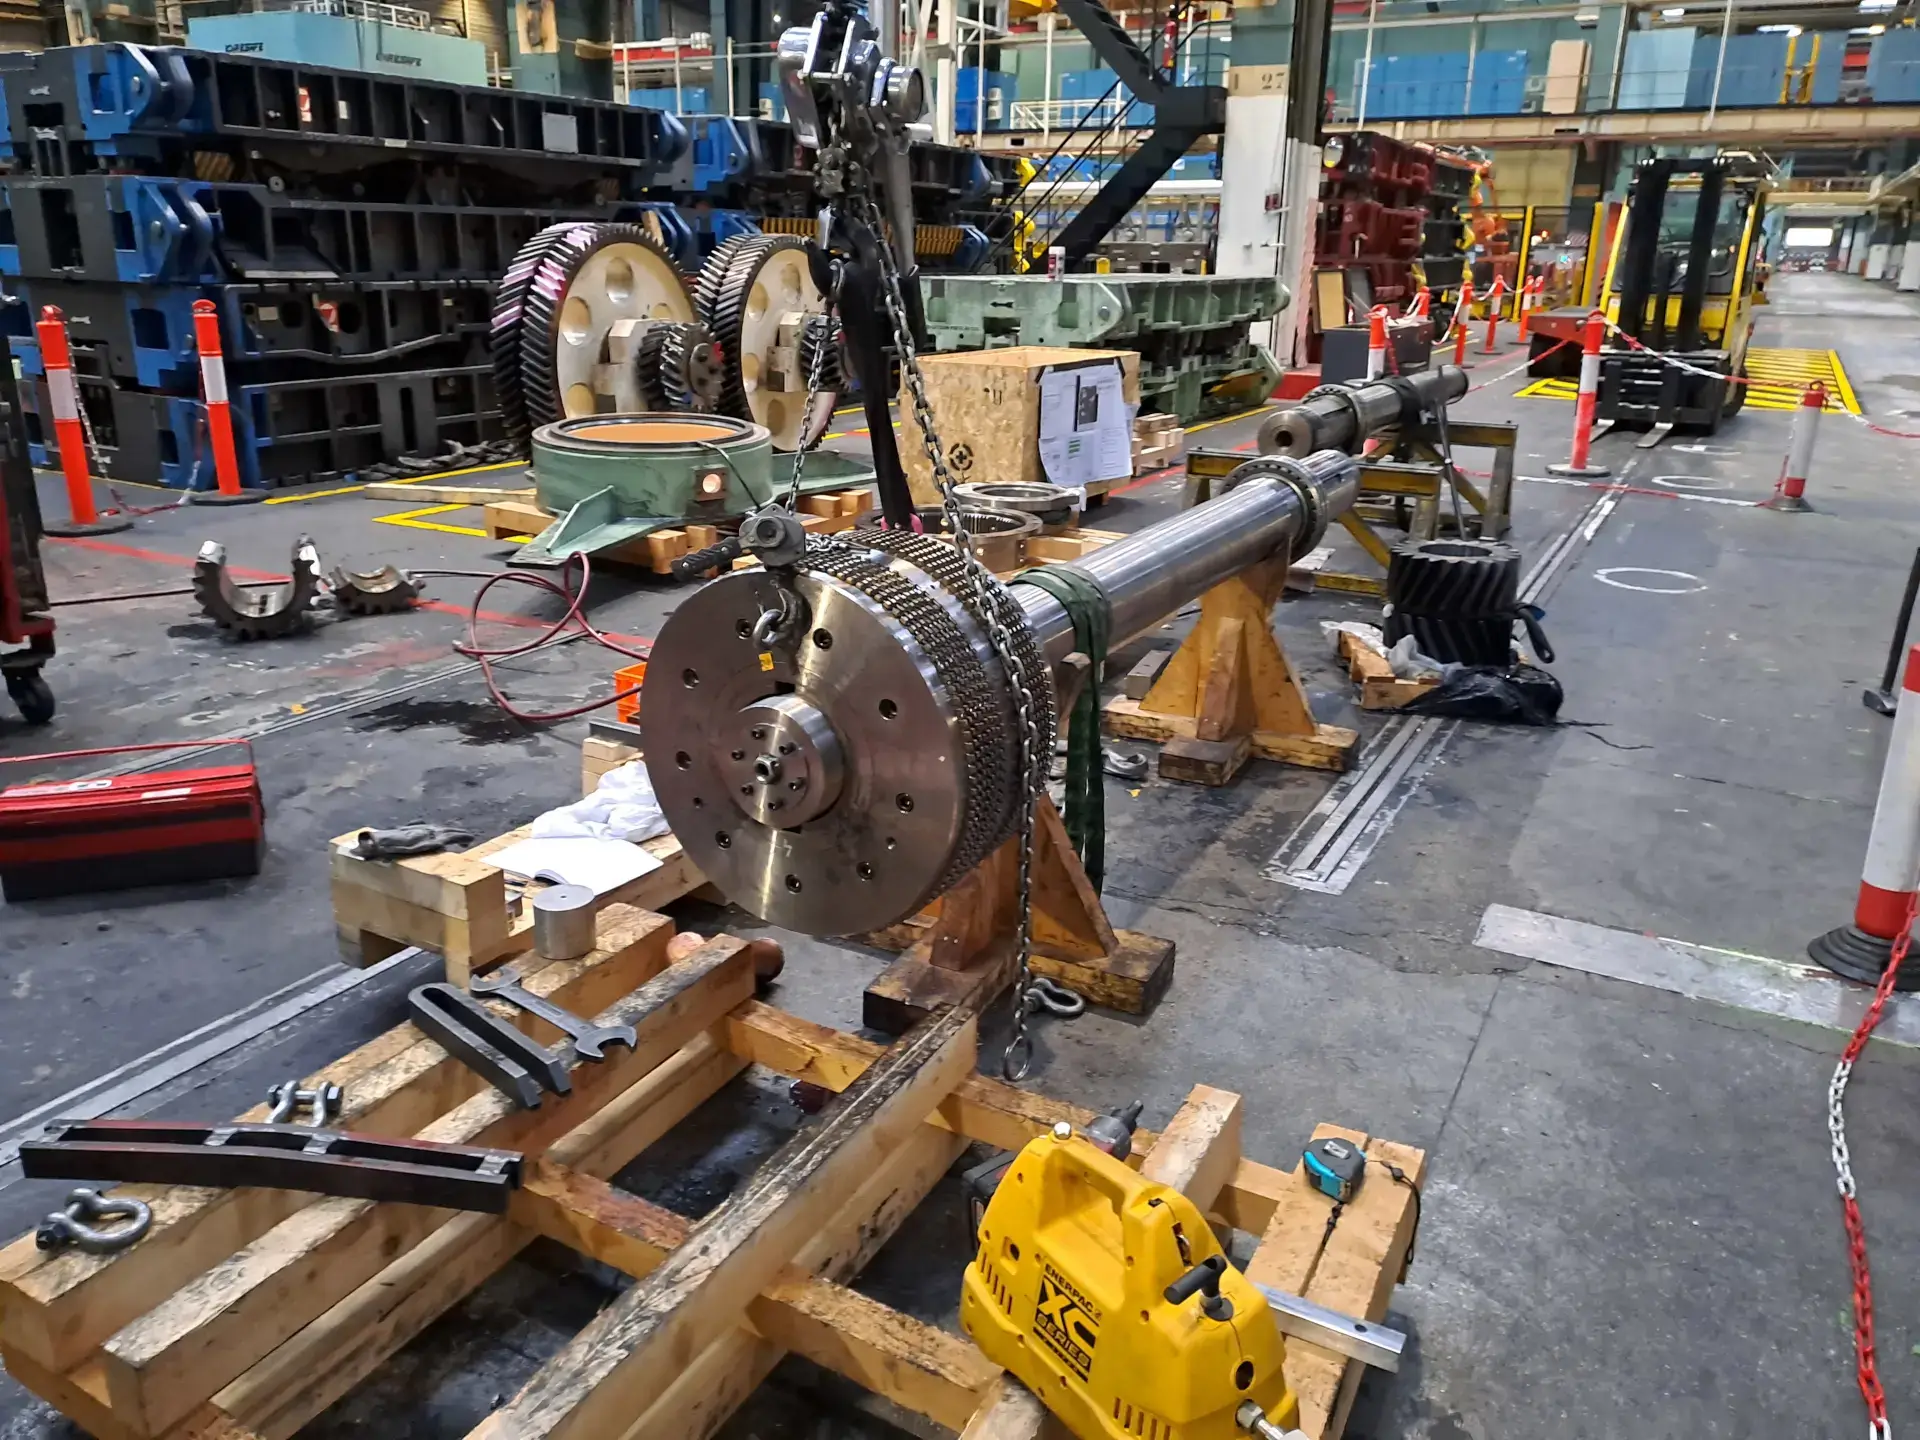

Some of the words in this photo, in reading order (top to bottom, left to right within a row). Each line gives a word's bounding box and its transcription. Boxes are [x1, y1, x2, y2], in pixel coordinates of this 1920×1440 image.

[1261, 71, 1285, 89] 27
[1045, 1263, 1094, 1313] ENERPAC
[1037, 1312, 1090, 1367] SERIES
[1038, 1279, 1097, 1358] XC
